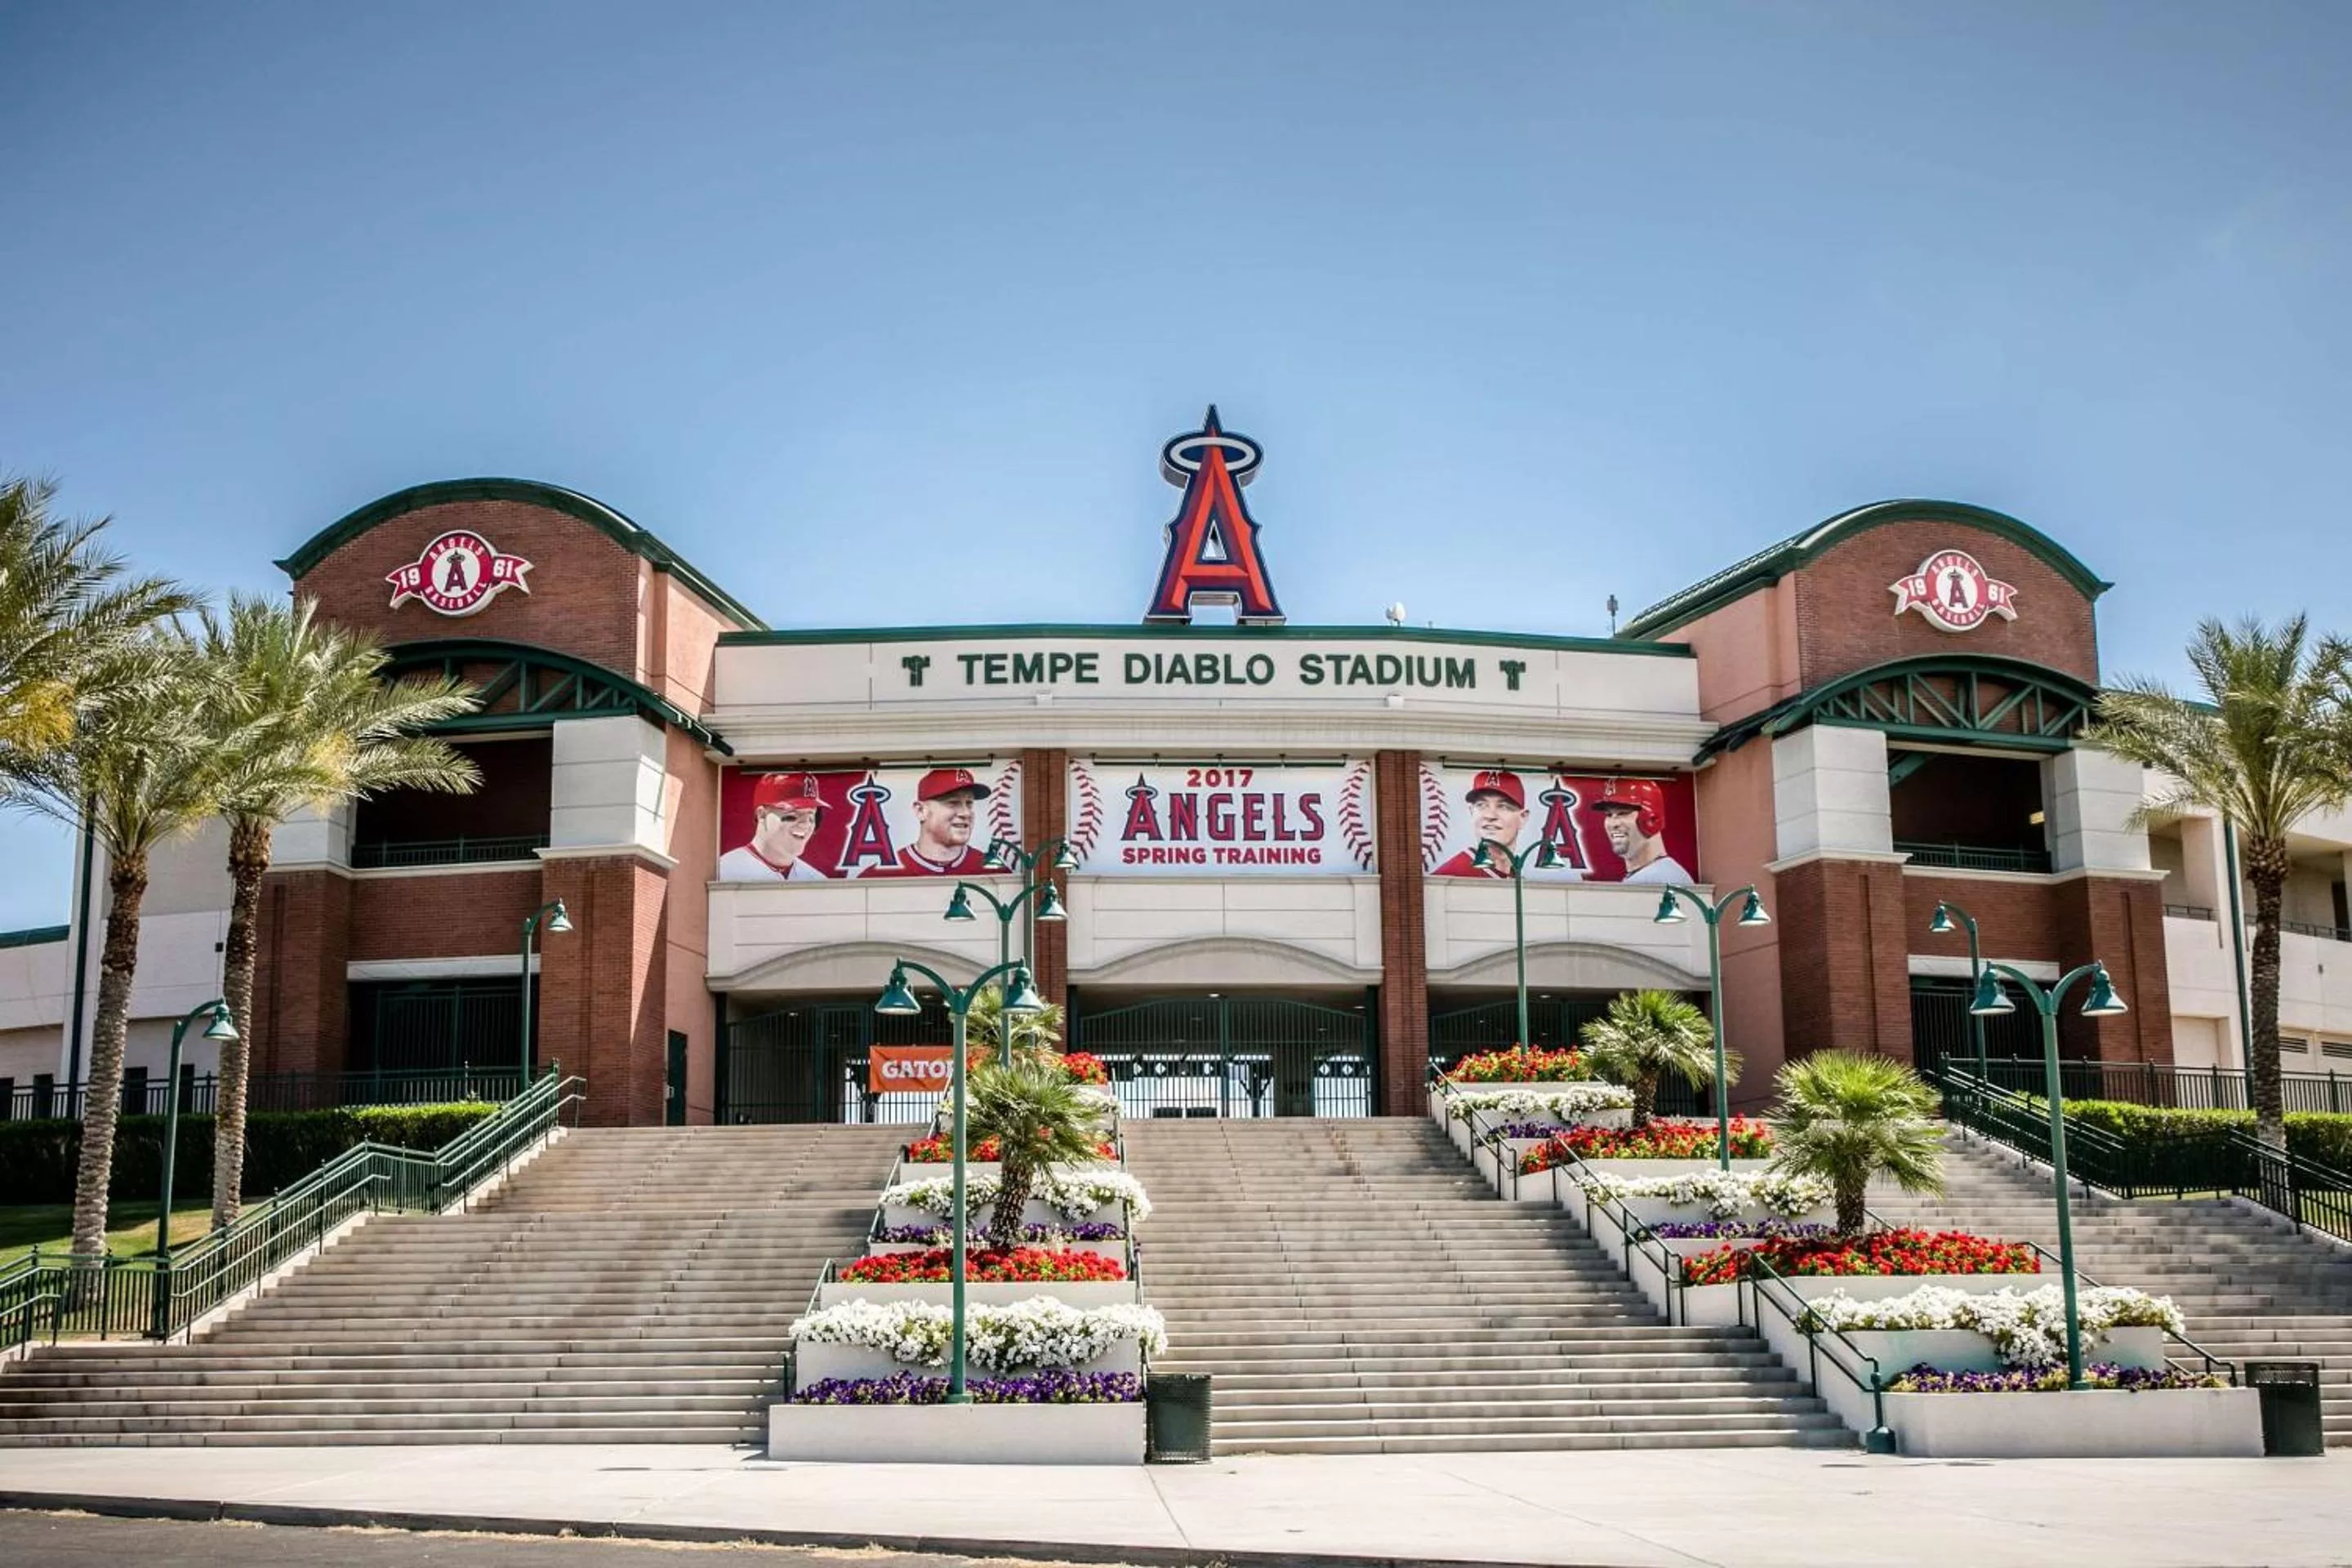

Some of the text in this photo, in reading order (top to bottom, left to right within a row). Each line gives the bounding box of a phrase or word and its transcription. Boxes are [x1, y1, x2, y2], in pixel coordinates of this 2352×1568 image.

[1143, 403, 1285, 621] A
[429, 536, 486, 560] ANGELS
[399, 559, 514, 586] 19 61
[443, 548, 469, 593] A
[1907, 578, 1927, 597] 19
[956, 653, 1099, 686] TEMPE
[1124, 653, 1276, 685] DIABLO
[1298, 653, 1477, 689] STADIUM
[1186, 768, 1254, 788] 2017
[841, 773, 899, 867] A
[1120, 773, 1325, 842] ANGELS
[1535, 777, 1588, 870] A
[1121, 846, 1321, 865] SPRING TRAINING
